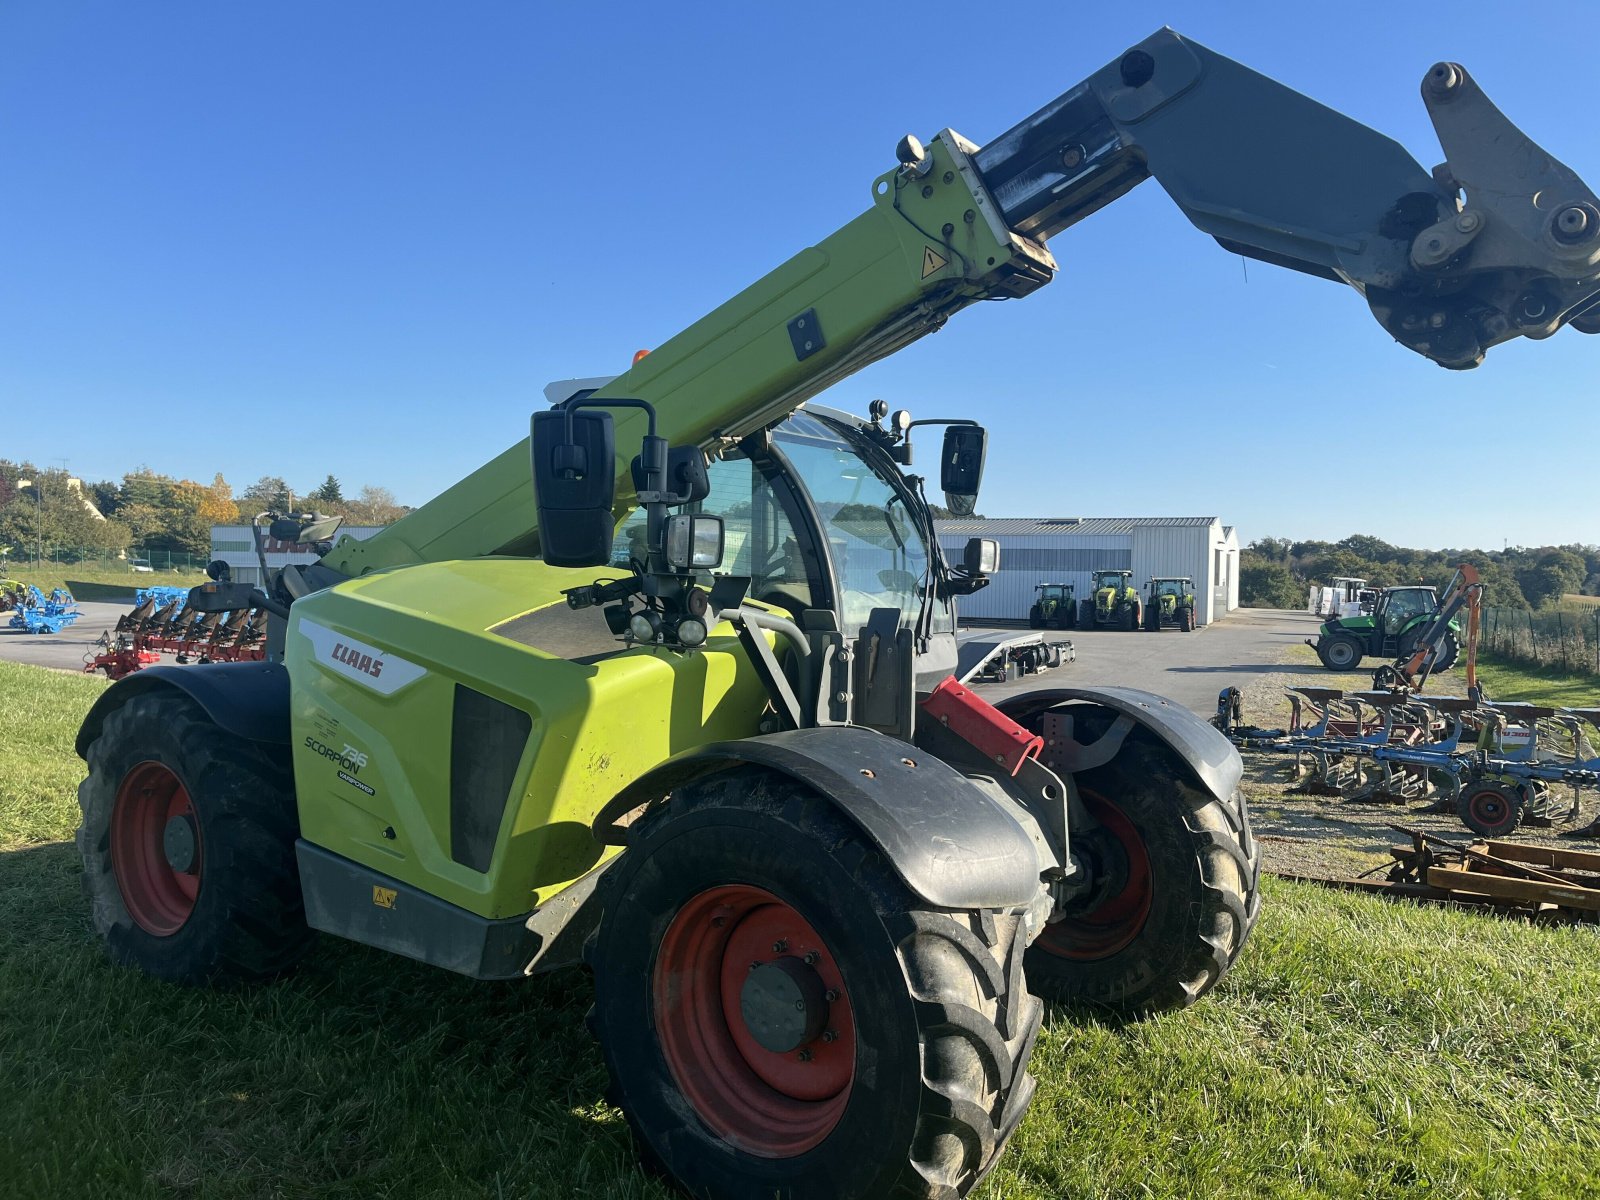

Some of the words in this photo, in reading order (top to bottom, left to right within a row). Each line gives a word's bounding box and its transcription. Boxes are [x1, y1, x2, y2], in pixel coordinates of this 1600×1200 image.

[332, 643, 384, 678] CLAAS
[304, 736, 360, 774] SCORPION
[341, 742, 369, 768] 736
[339, 772, 374, 795] VARIPOWER
